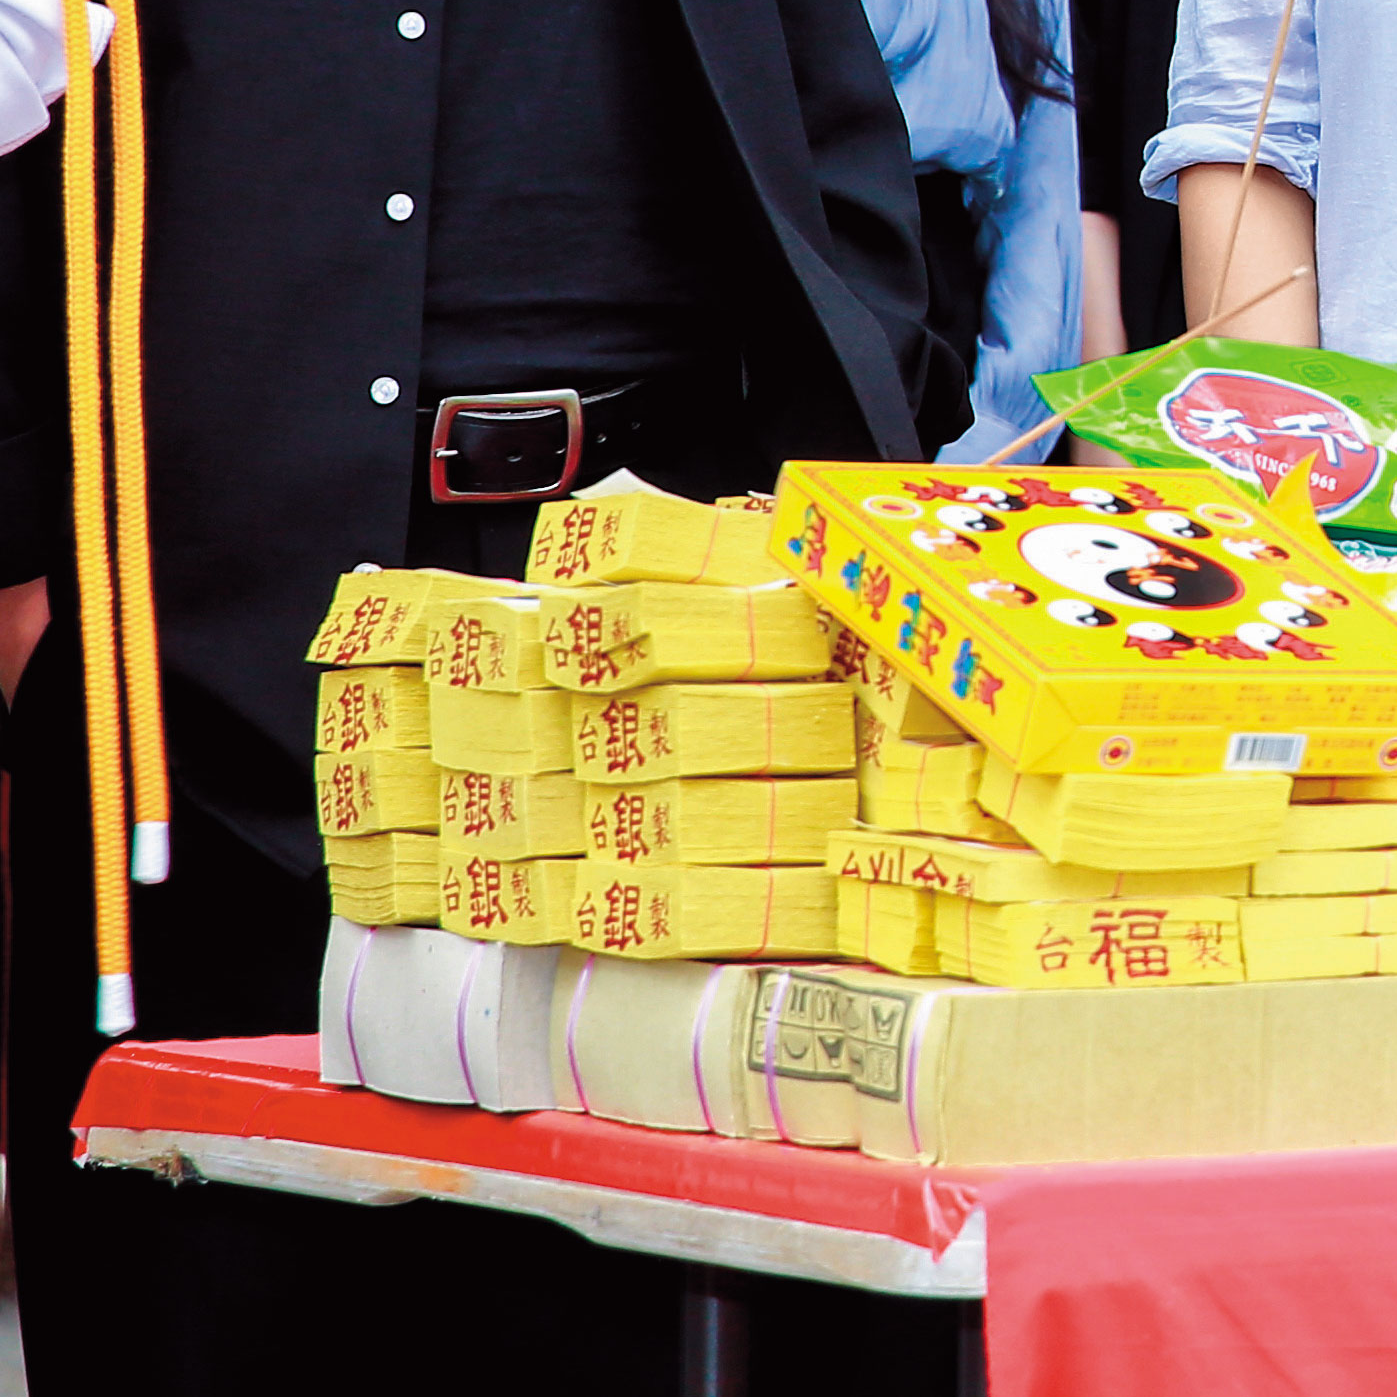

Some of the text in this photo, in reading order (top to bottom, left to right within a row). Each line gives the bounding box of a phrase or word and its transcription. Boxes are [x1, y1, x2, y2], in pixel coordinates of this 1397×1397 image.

[1255, 453, 1337, 492] SINC 968
[578, 699, 673, 773] 台銀製
[590, 793, 670, 863] 台銀製
[576, 882, 670, 951] 台銀製
[1035, 909, 1231, 985] 台福製
